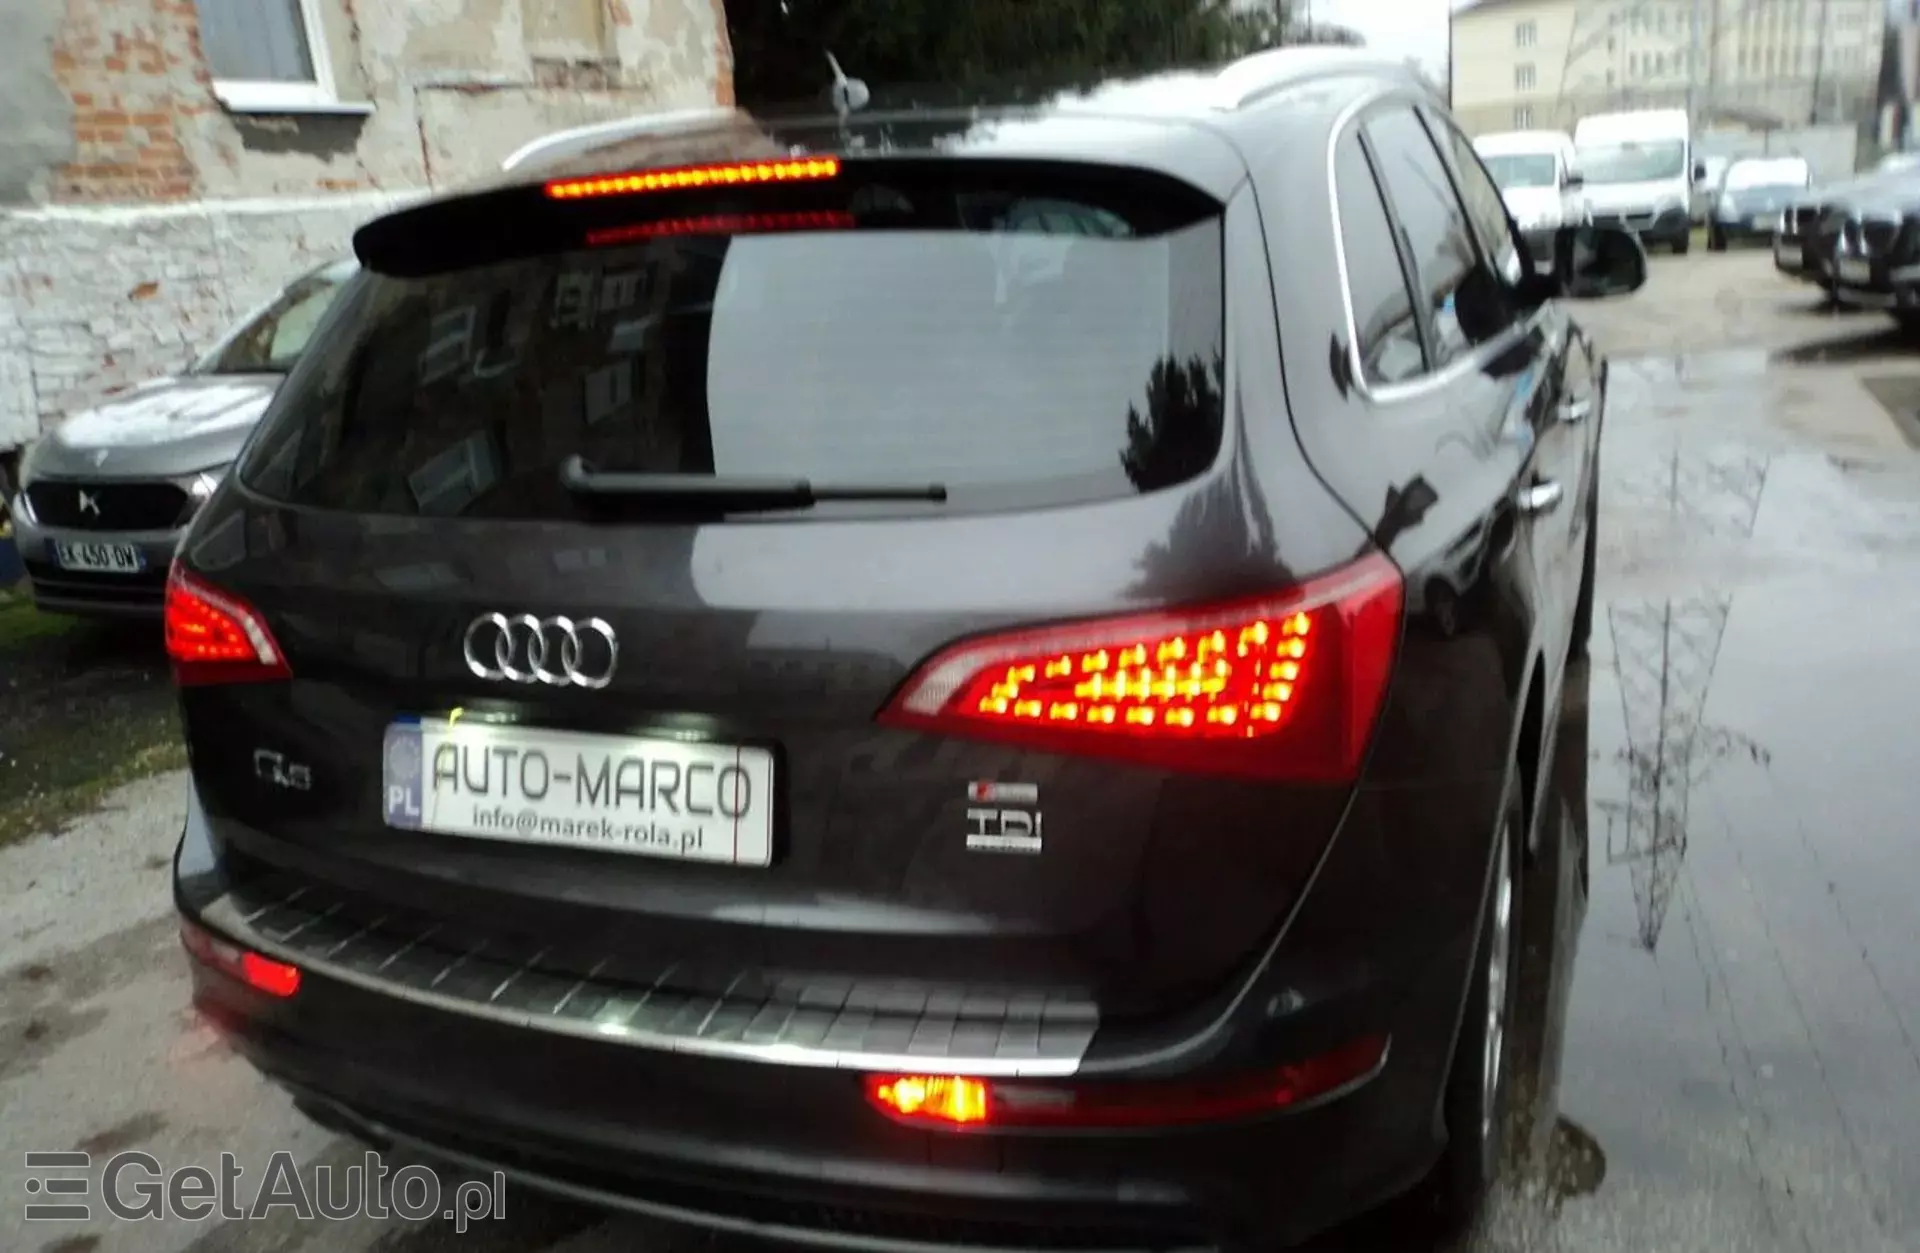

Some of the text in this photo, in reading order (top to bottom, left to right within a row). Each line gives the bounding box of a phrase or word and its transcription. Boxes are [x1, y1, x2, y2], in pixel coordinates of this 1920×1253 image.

[387, 784, 420, 816] PL
[433, 742, 751, 819] AUTO-MARCO
[473, 805, 703, 856] info@marek-rola.pl
[967, 809, 1042, 836] TDI
